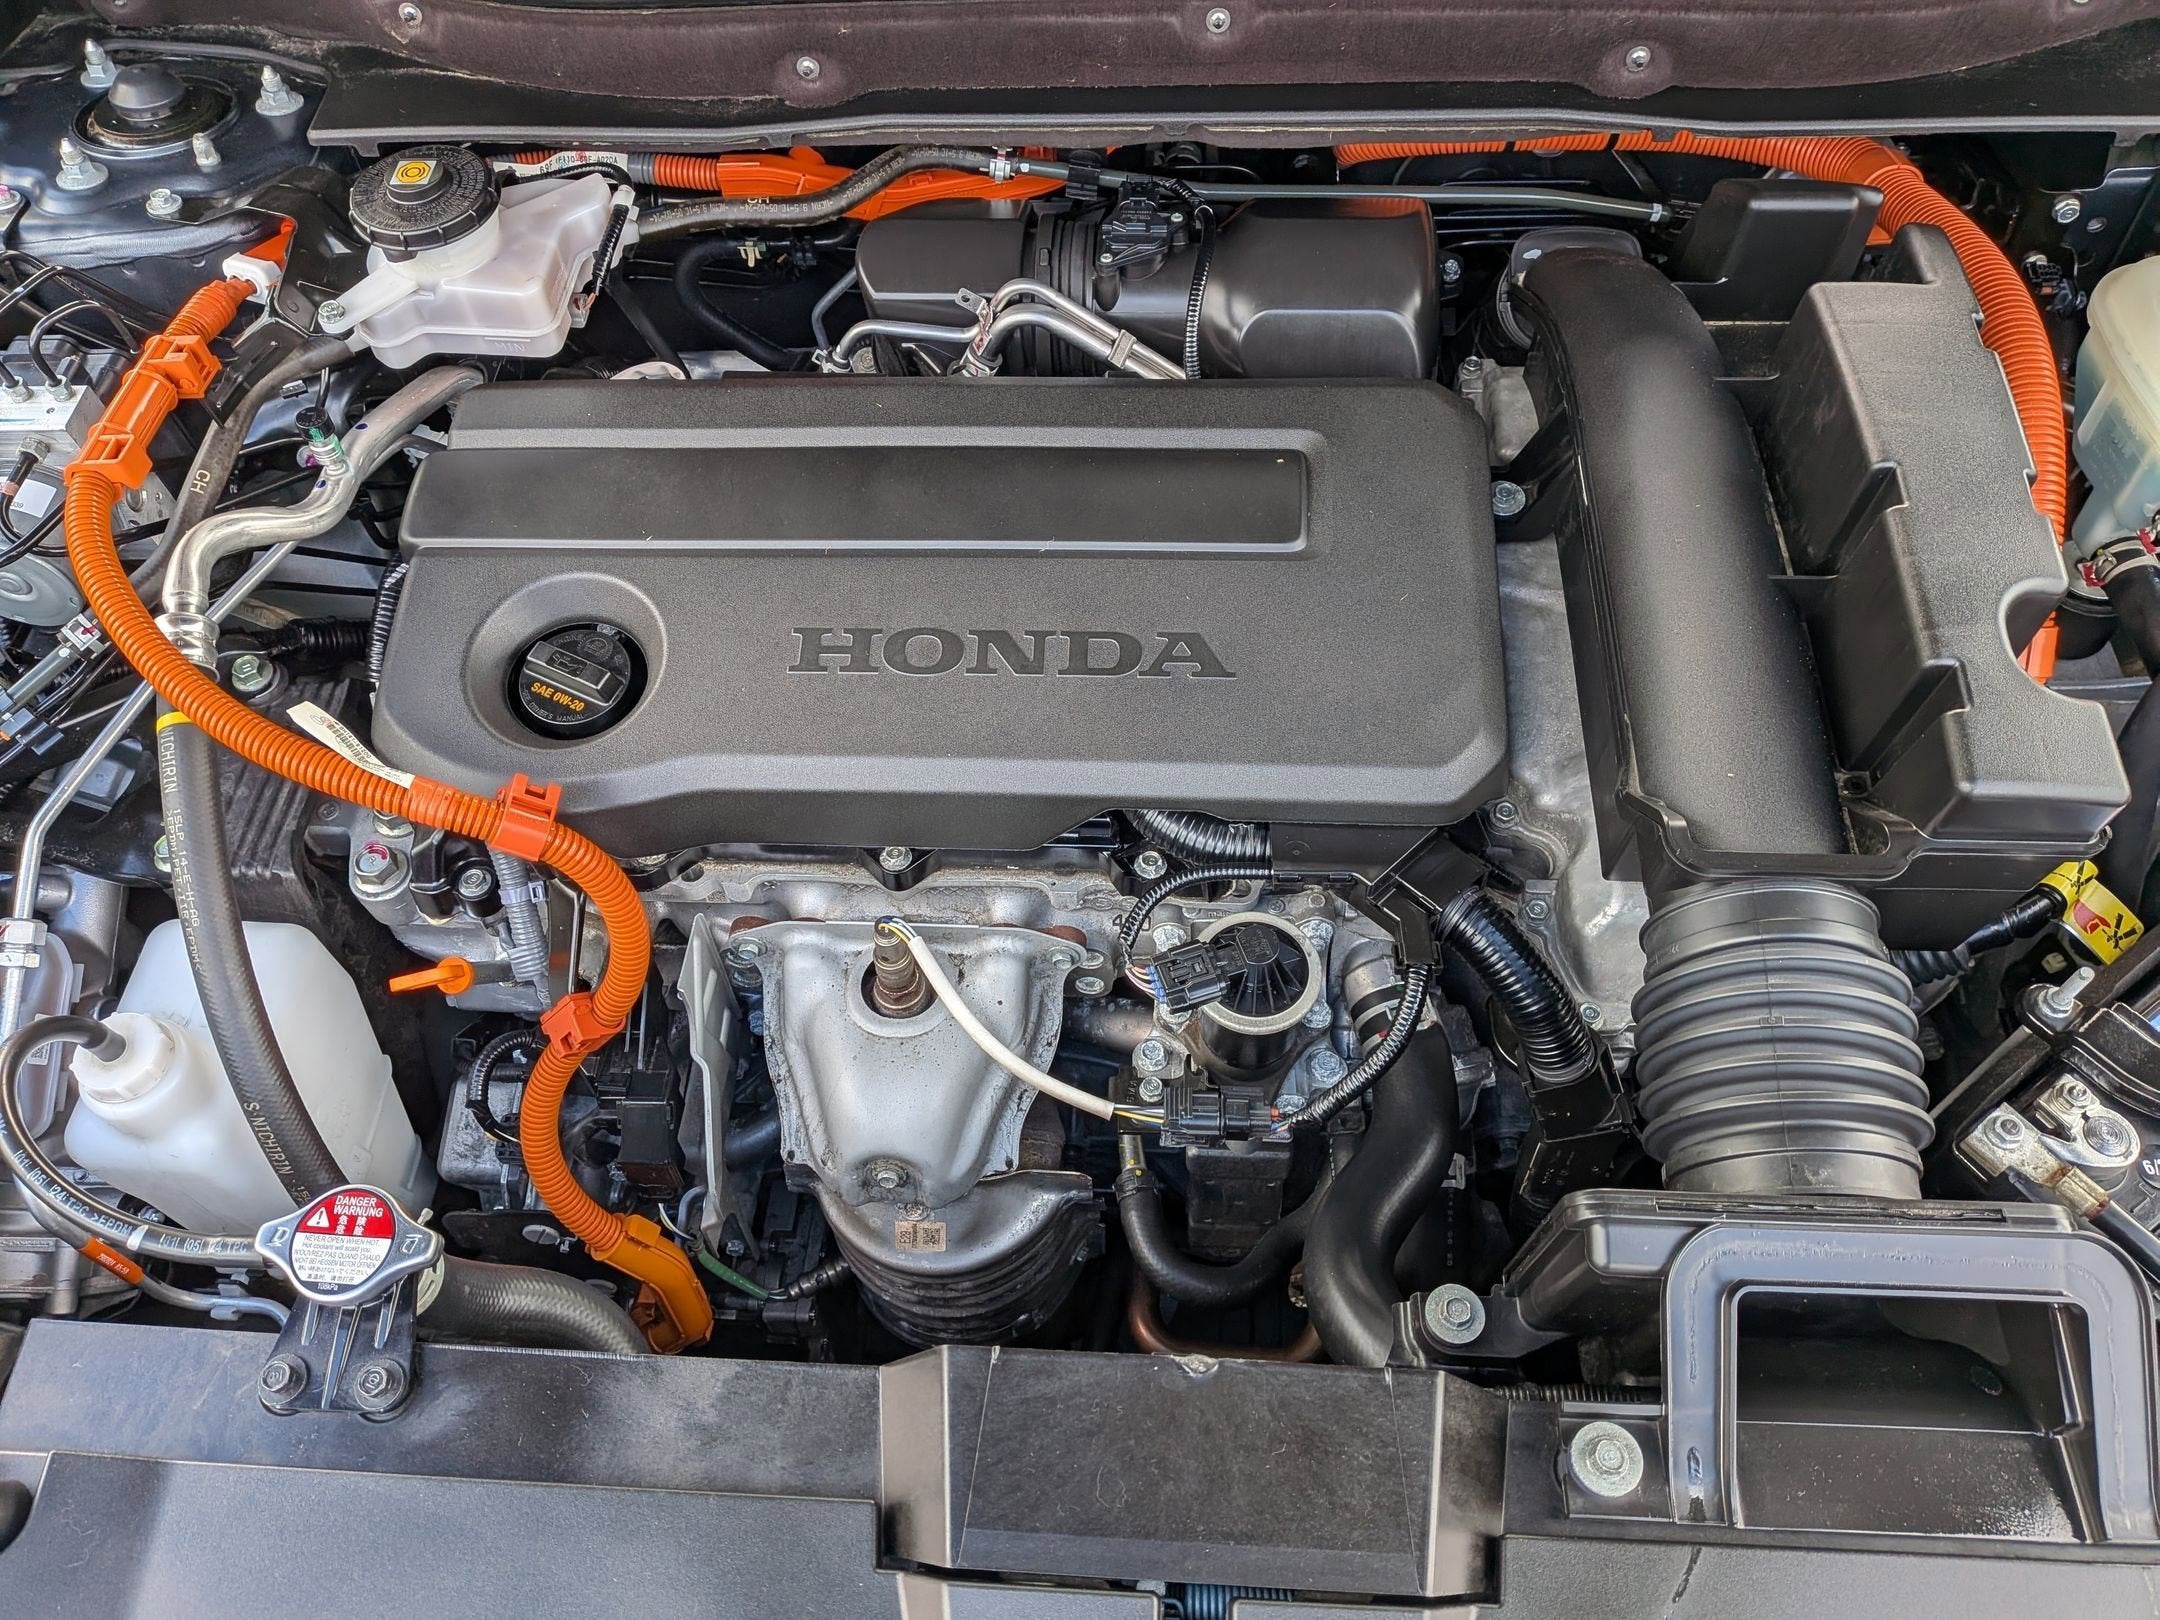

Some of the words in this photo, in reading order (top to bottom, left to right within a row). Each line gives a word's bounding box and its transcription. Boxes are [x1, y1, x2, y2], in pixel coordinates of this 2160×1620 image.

[189, 469, 211, 495] CH
[786, 626, 1240, 681] HONDA
[530, 681, 555, 699] SAE
[553, 691, 586, 713] 0W-20
[159, 727, 179, 794] NICHIRIN
[333, 1204, 384, 1218] WARNUNG
[335, 1195, 378, 1207] DANGER
[304, 1234, 327, 1243] NEVER
[326, 1236, 345, 1244] OPEN
[324, 1251, 338, 1259] PAS
[337, 1252, 359, 1260] QUAND
